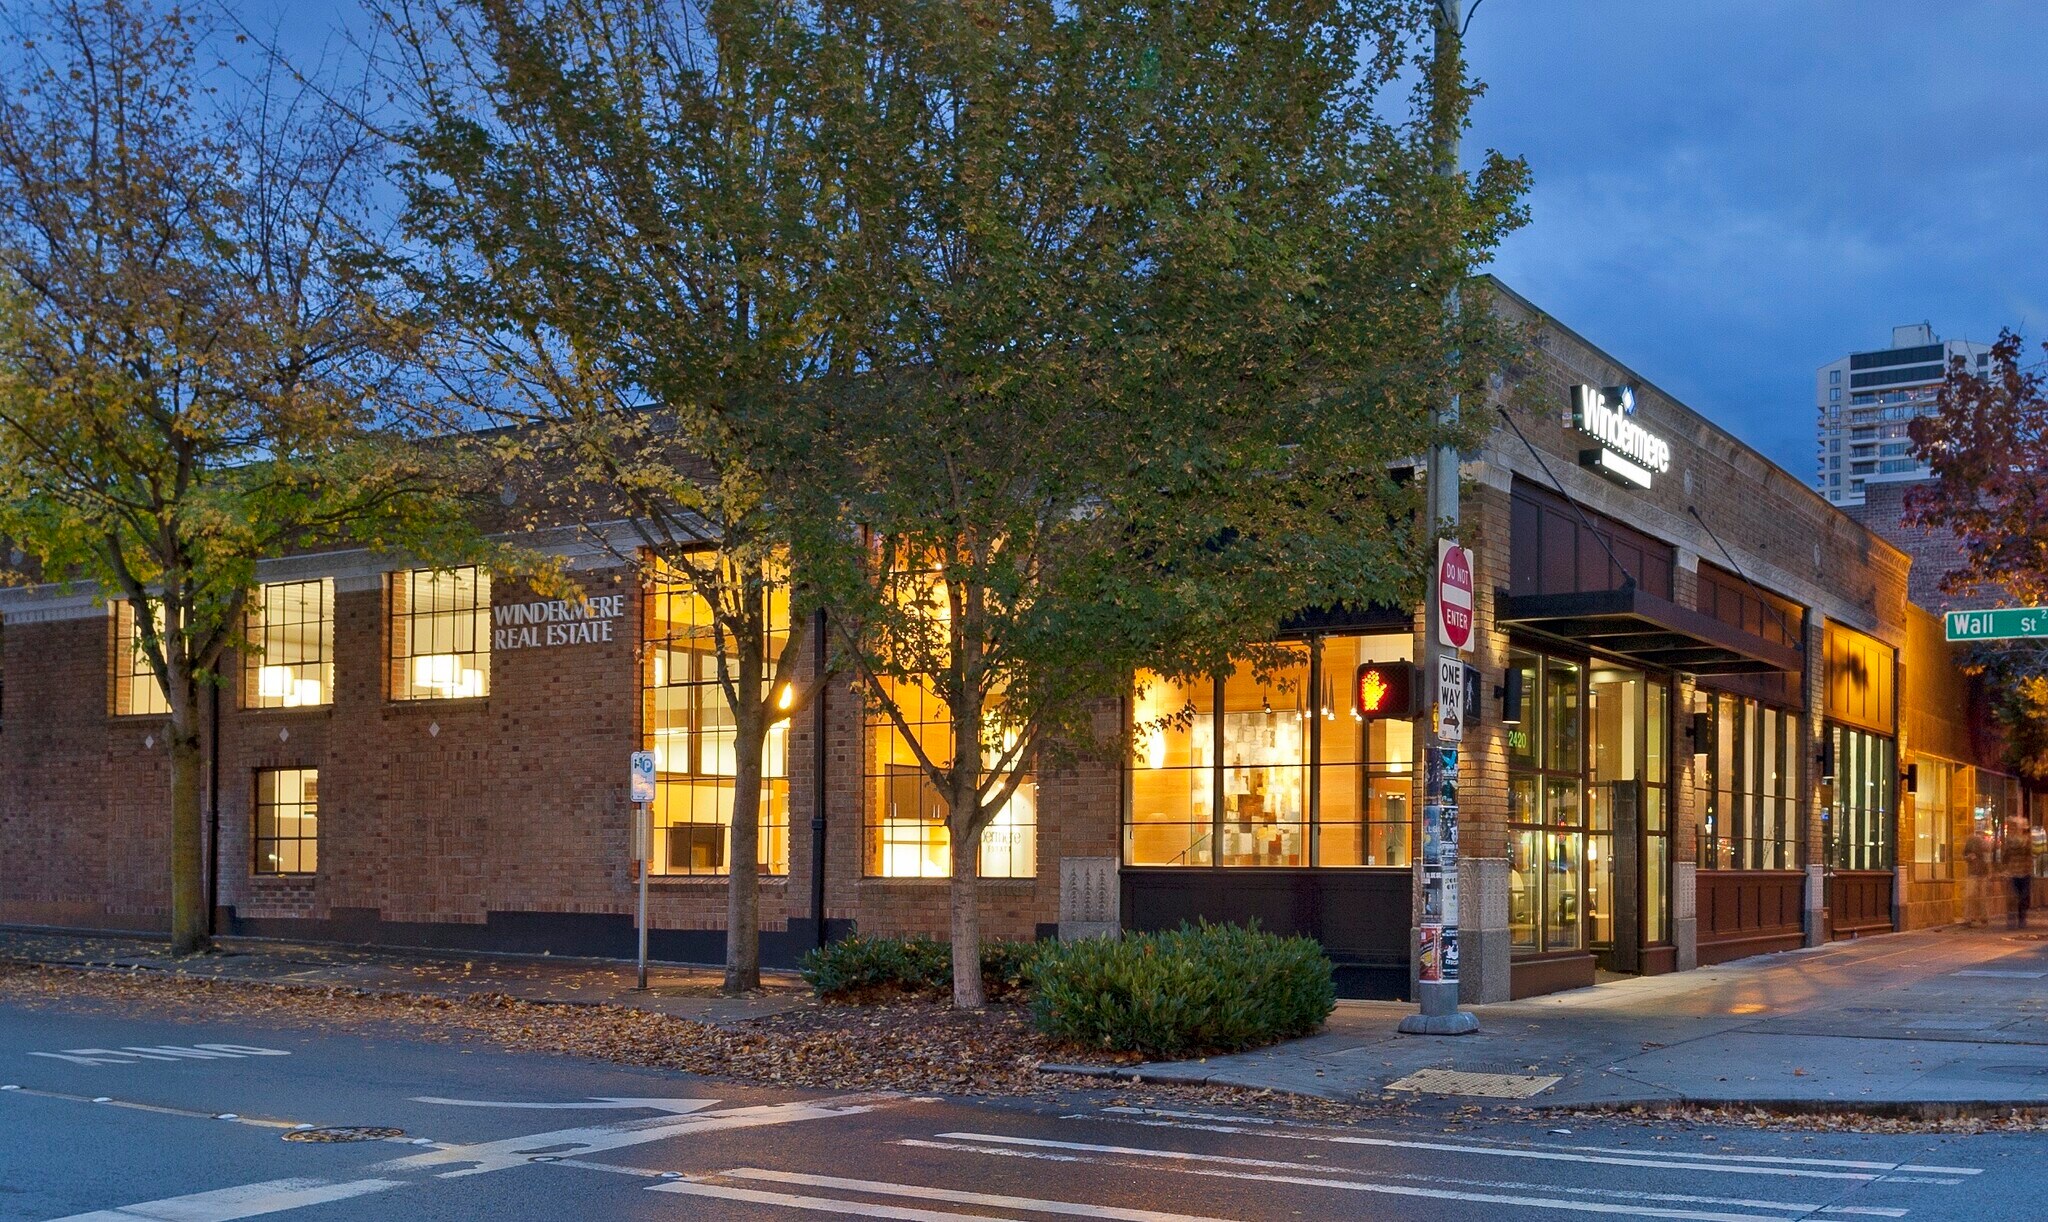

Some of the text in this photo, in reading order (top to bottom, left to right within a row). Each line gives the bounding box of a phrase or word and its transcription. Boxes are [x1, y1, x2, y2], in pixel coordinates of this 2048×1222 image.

[1581, 384, 1670, 473] Windermere
[1446, 562, 1469, 585] DO NOT
[494, 594, 624, 626] WINDERMERE
[1446, 608, 1468, 630] ENTER
[494, 620, 613, 650] REAL ESTATE
[1953, 613, 1994, 635] Wall
[2021, 617, 2037, 632] St
[1441, 663, 1460, 685] ONE
[1441, 686, 1461, 708] WAY
[1508, 730, 1527, 749] 2420
